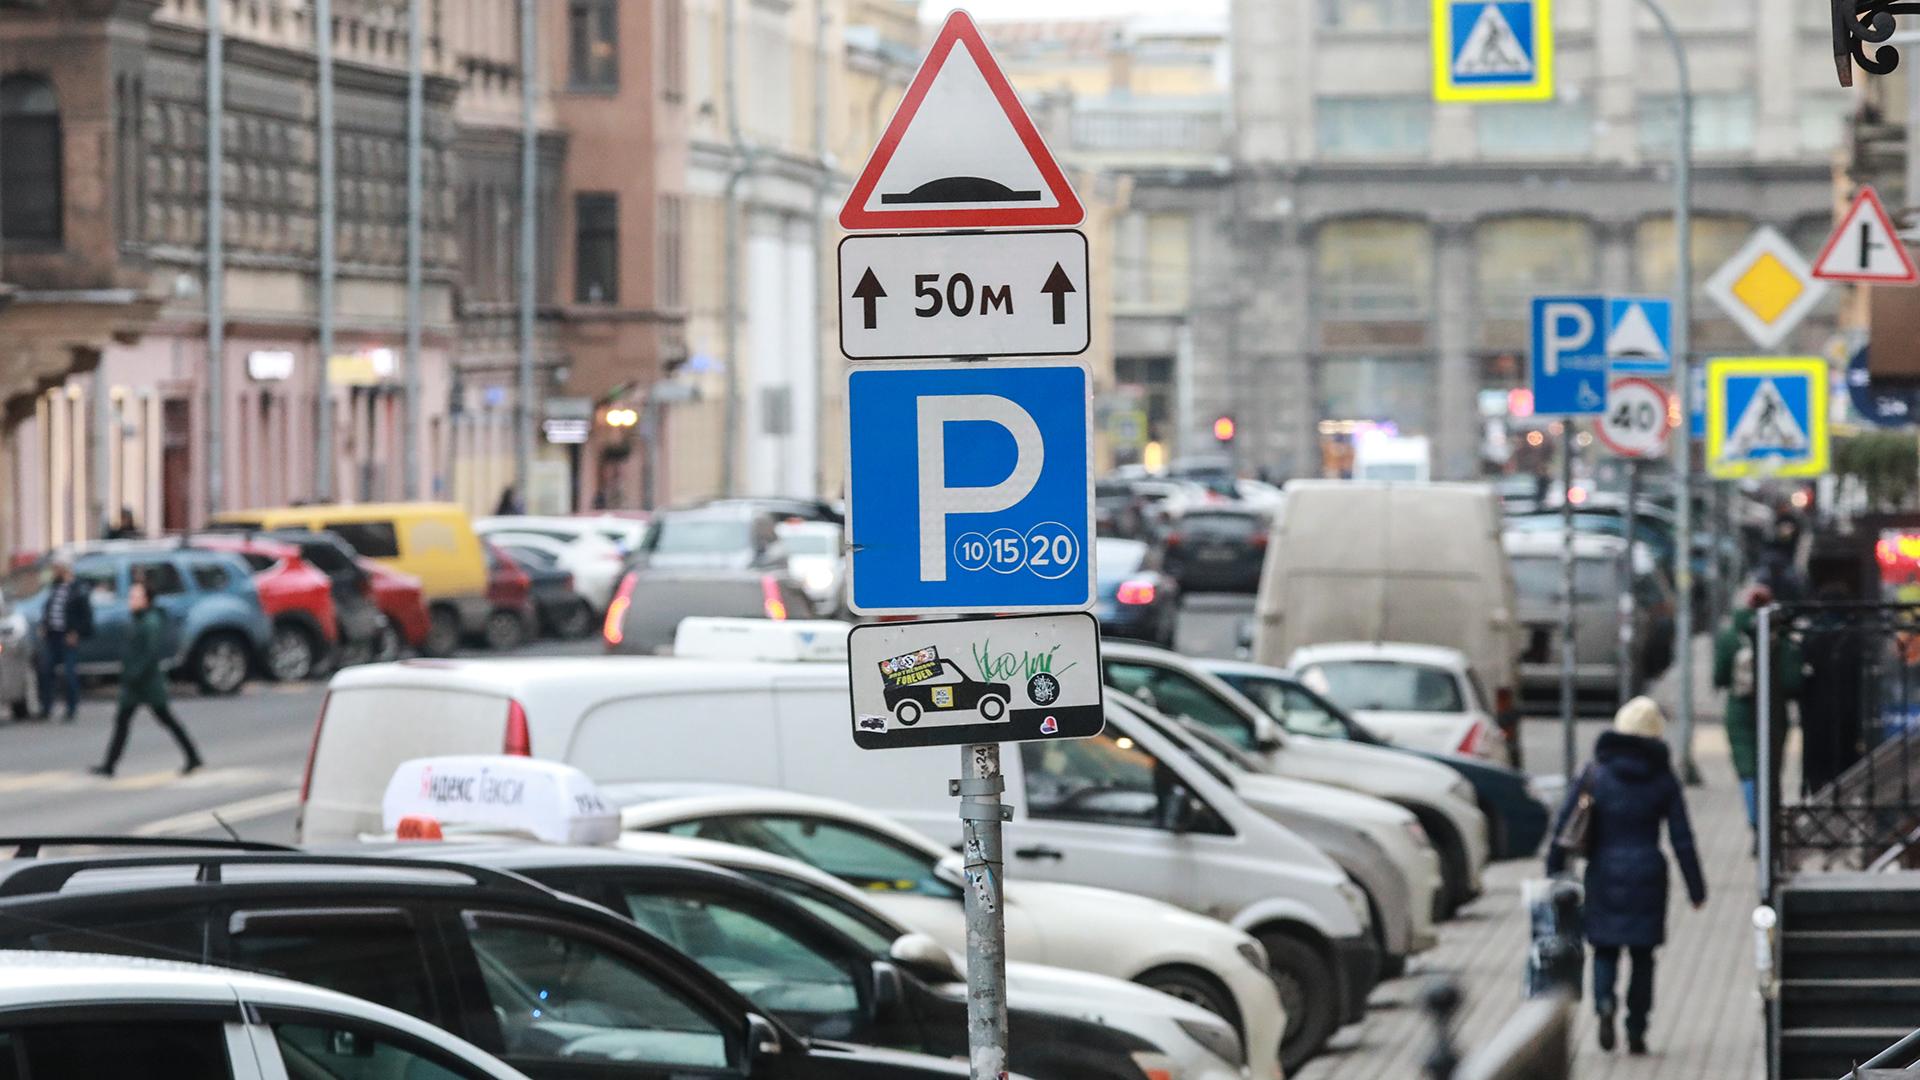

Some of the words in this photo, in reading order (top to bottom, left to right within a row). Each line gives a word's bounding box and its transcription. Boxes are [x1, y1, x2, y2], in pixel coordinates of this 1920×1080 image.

[914, 273, 1014, 318] 50м
[1543, 303, 1594, 375] P
[1612, 402, 1656, 431] 40
[917, 394, 1045, 582] P
[962, 542, 984, 561] 10
[992, 538, 1019, 563] 15
[1030, 534, 1072, 566] 20
